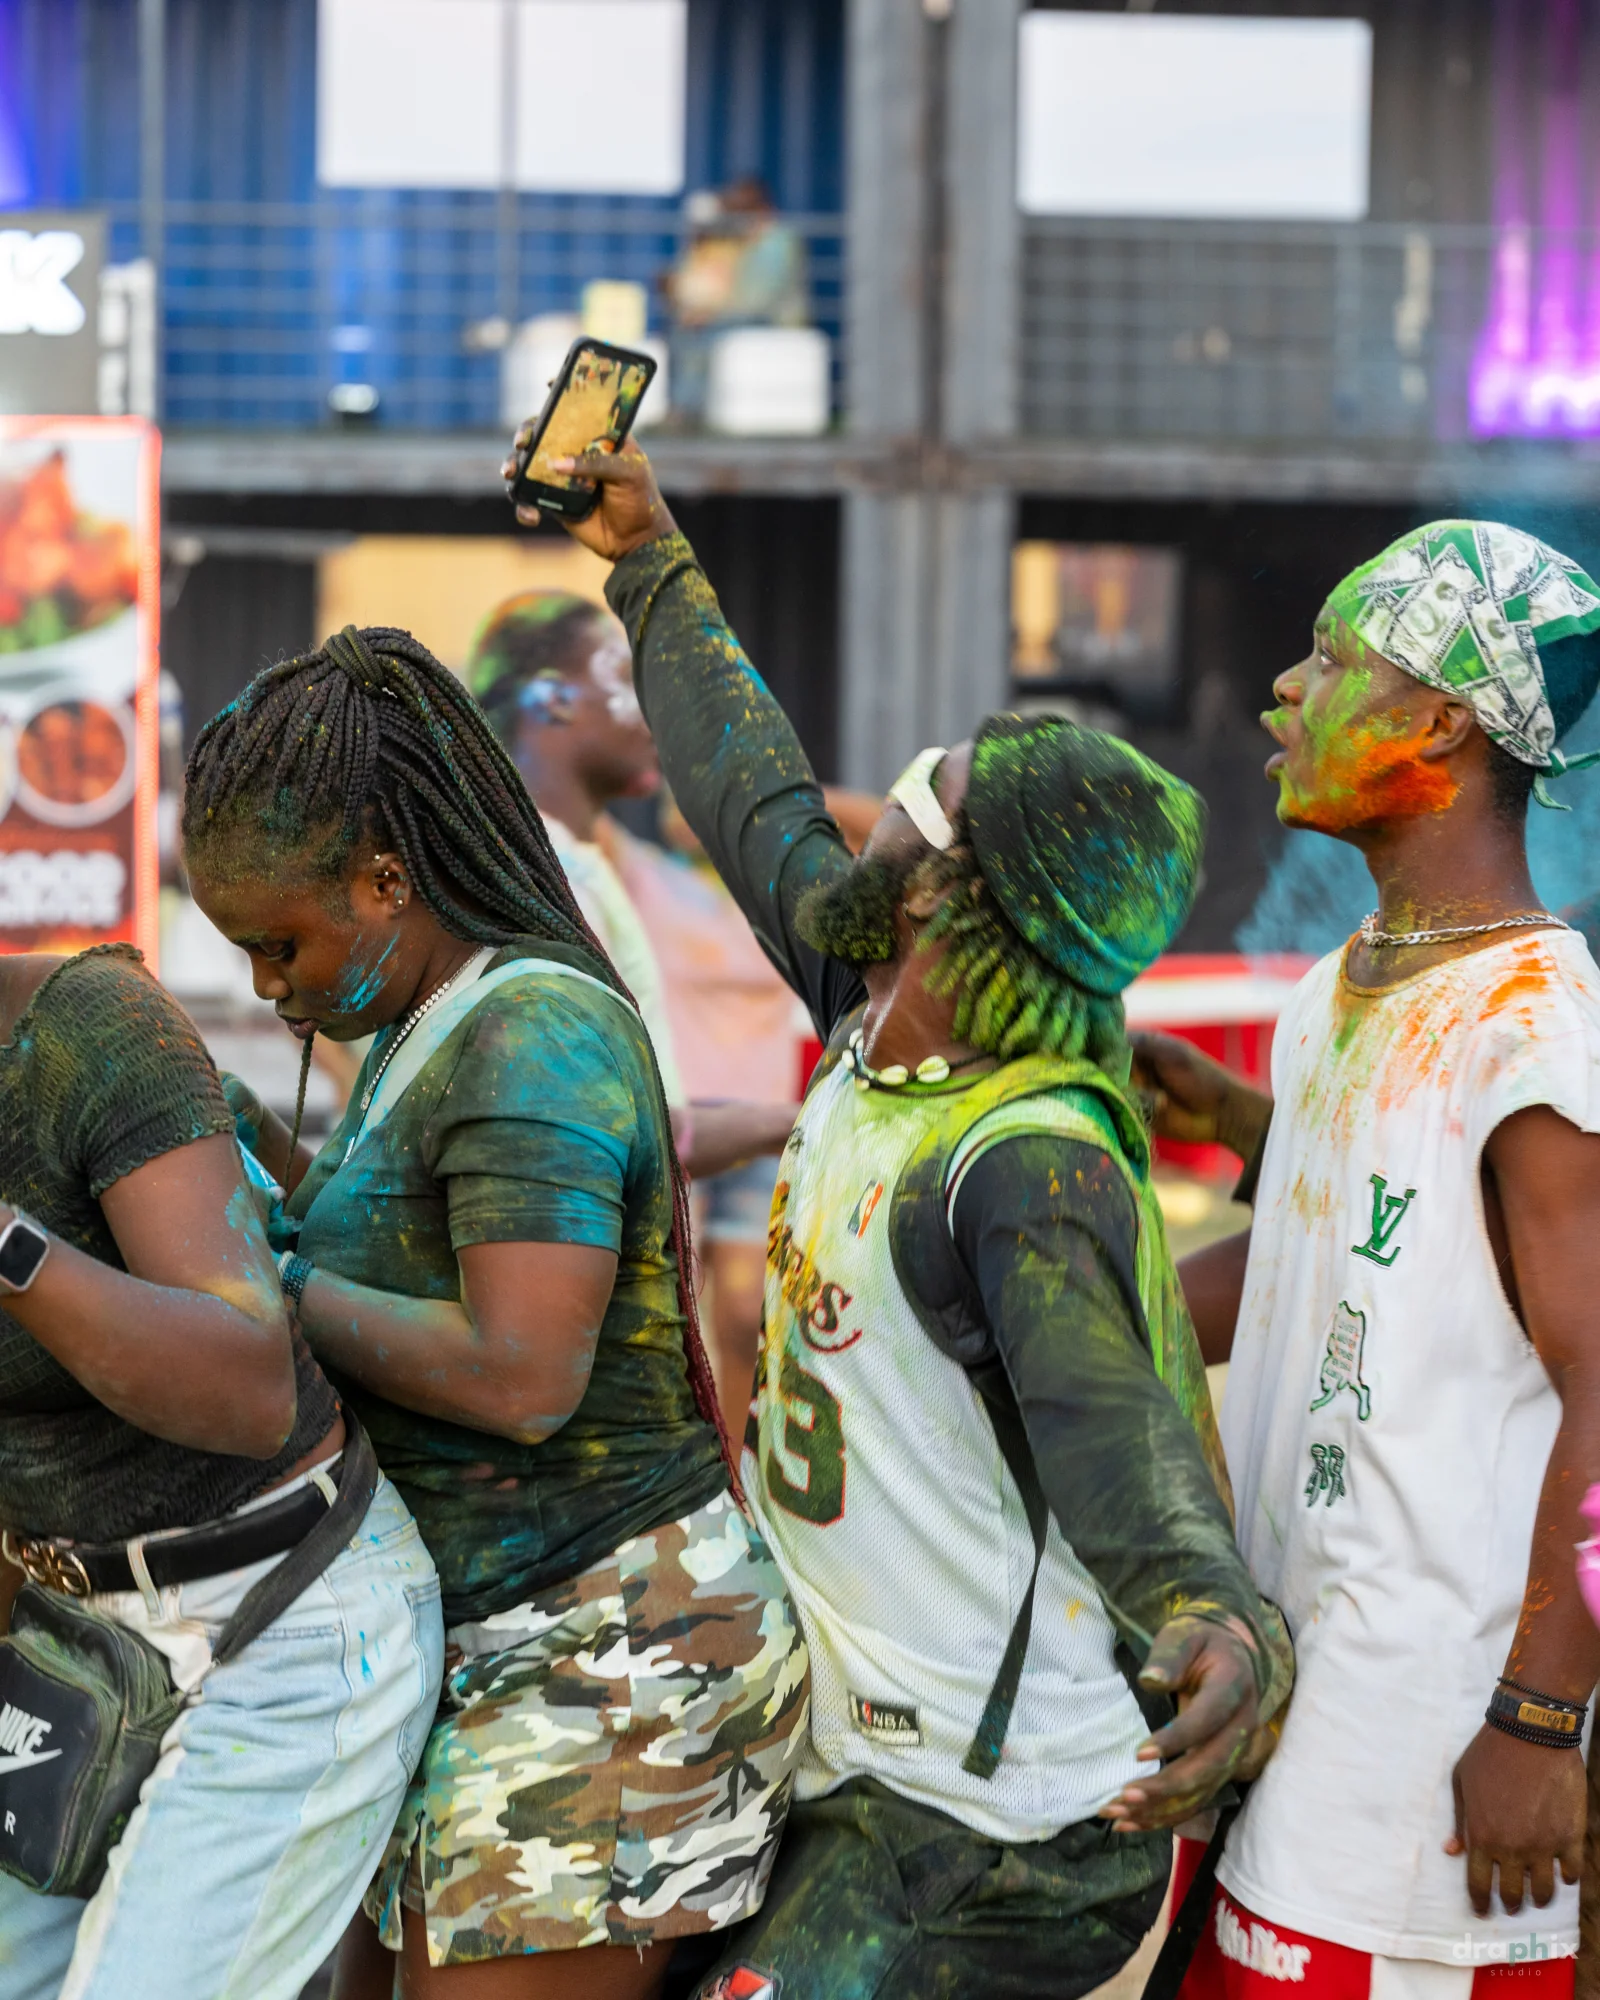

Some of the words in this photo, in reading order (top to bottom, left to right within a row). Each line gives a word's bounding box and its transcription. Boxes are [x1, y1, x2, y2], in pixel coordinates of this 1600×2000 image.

[0, 1701, 53, 1758] NIKE
[873, 1710, 911, 1730] NBA
[4, 1809, 17, 1836] R
